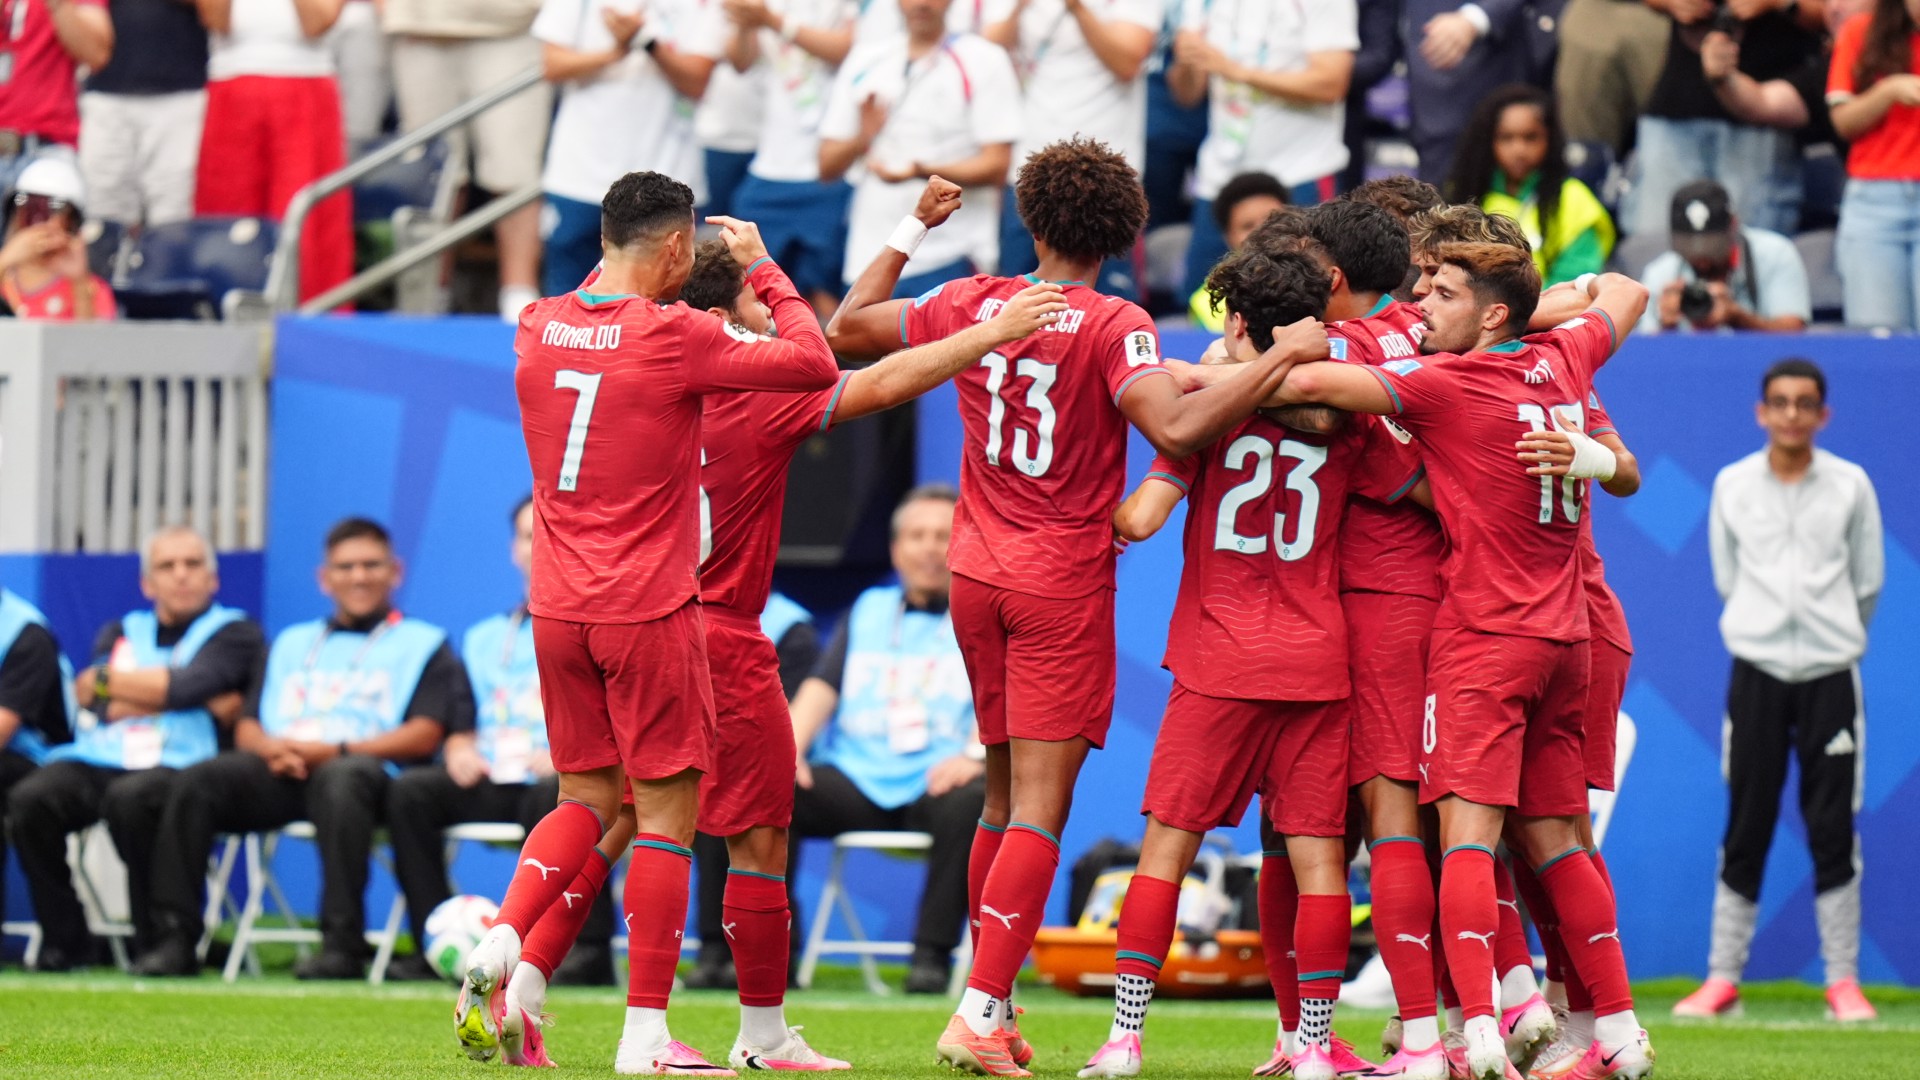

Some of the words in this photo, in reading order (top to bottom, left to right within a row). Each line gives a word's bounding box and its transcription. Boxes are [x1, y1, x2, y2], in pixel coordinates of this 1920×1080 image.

[541, 320, 622, 350] RONALDO
[1377, 330, 1415, 359] JOÃO
[554, 369, 604, 492] 7
[980, 352, 1058, 478] 13
[1214, 435, 1328, 562] 23
